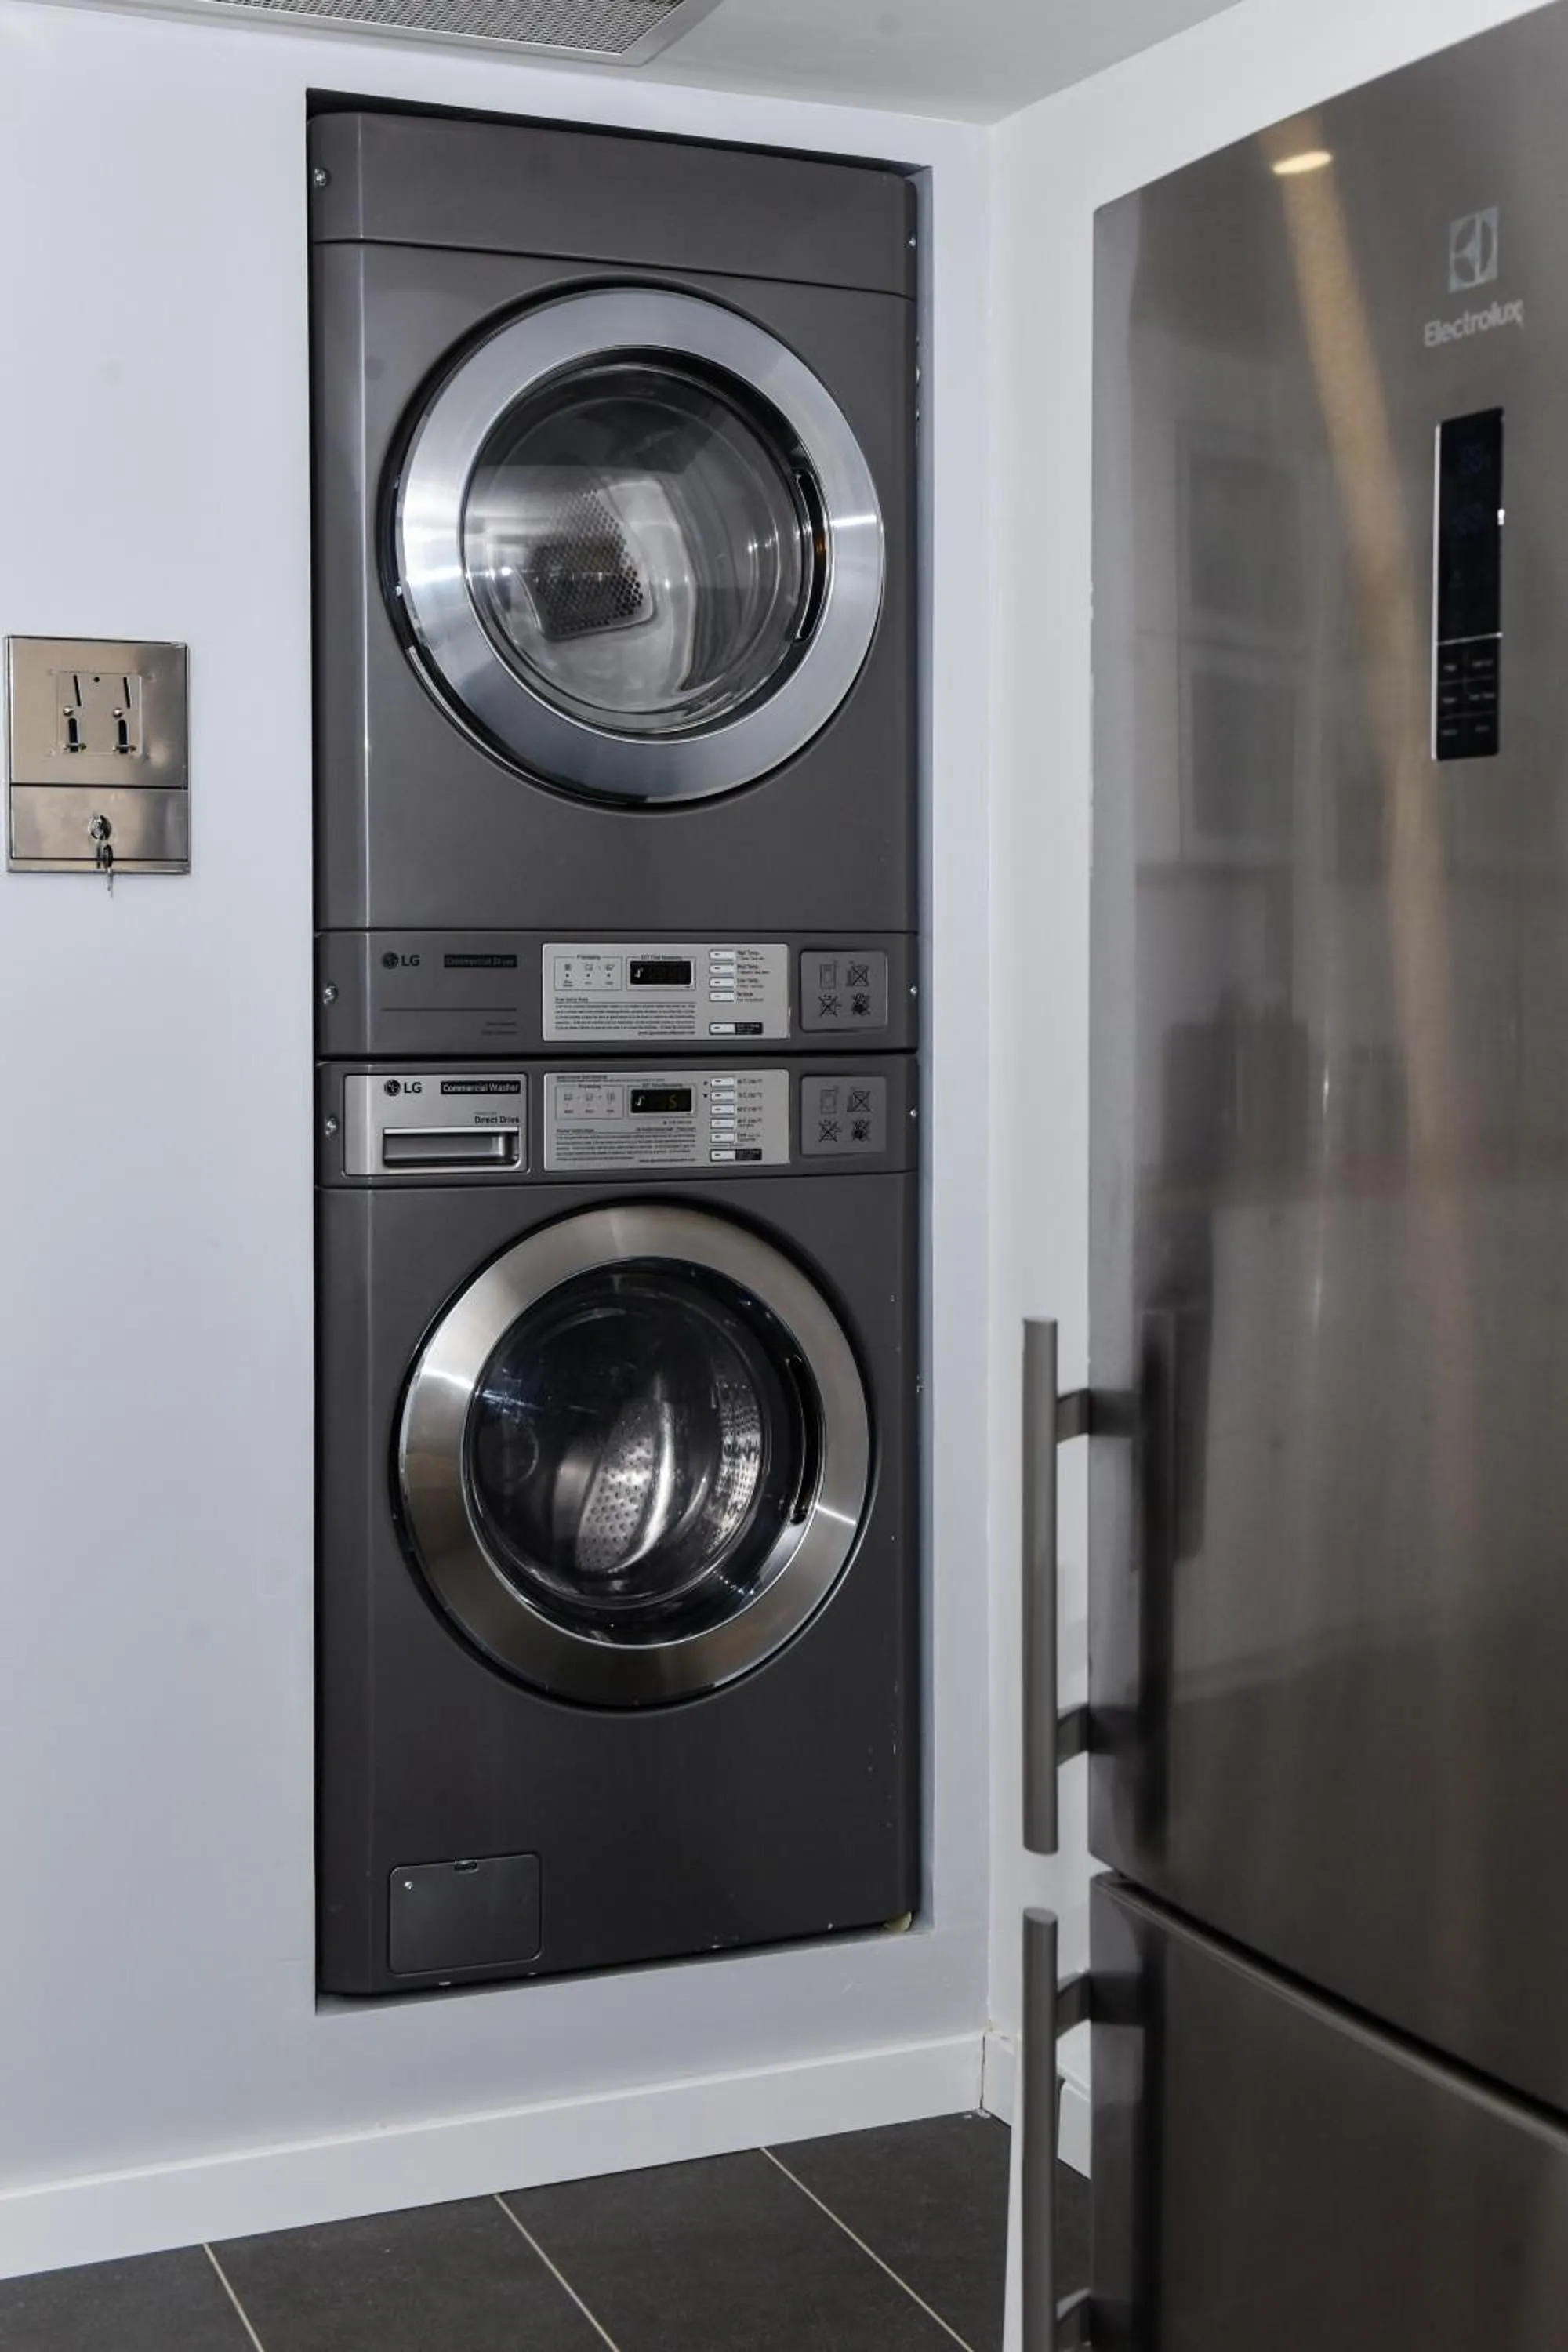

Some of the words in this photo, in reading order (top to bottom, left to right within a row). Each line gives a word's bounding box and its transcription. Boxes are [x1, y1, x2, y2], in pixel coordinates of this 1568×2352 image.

[1424, 299, 1523, 347] Electrolux
[401, 955, 420, 967] LG
[404, 1082, 422, 1094] LG
[443, 1083, 488, 1092] Commercial
[488, 1083, 519, 1092] Washer
